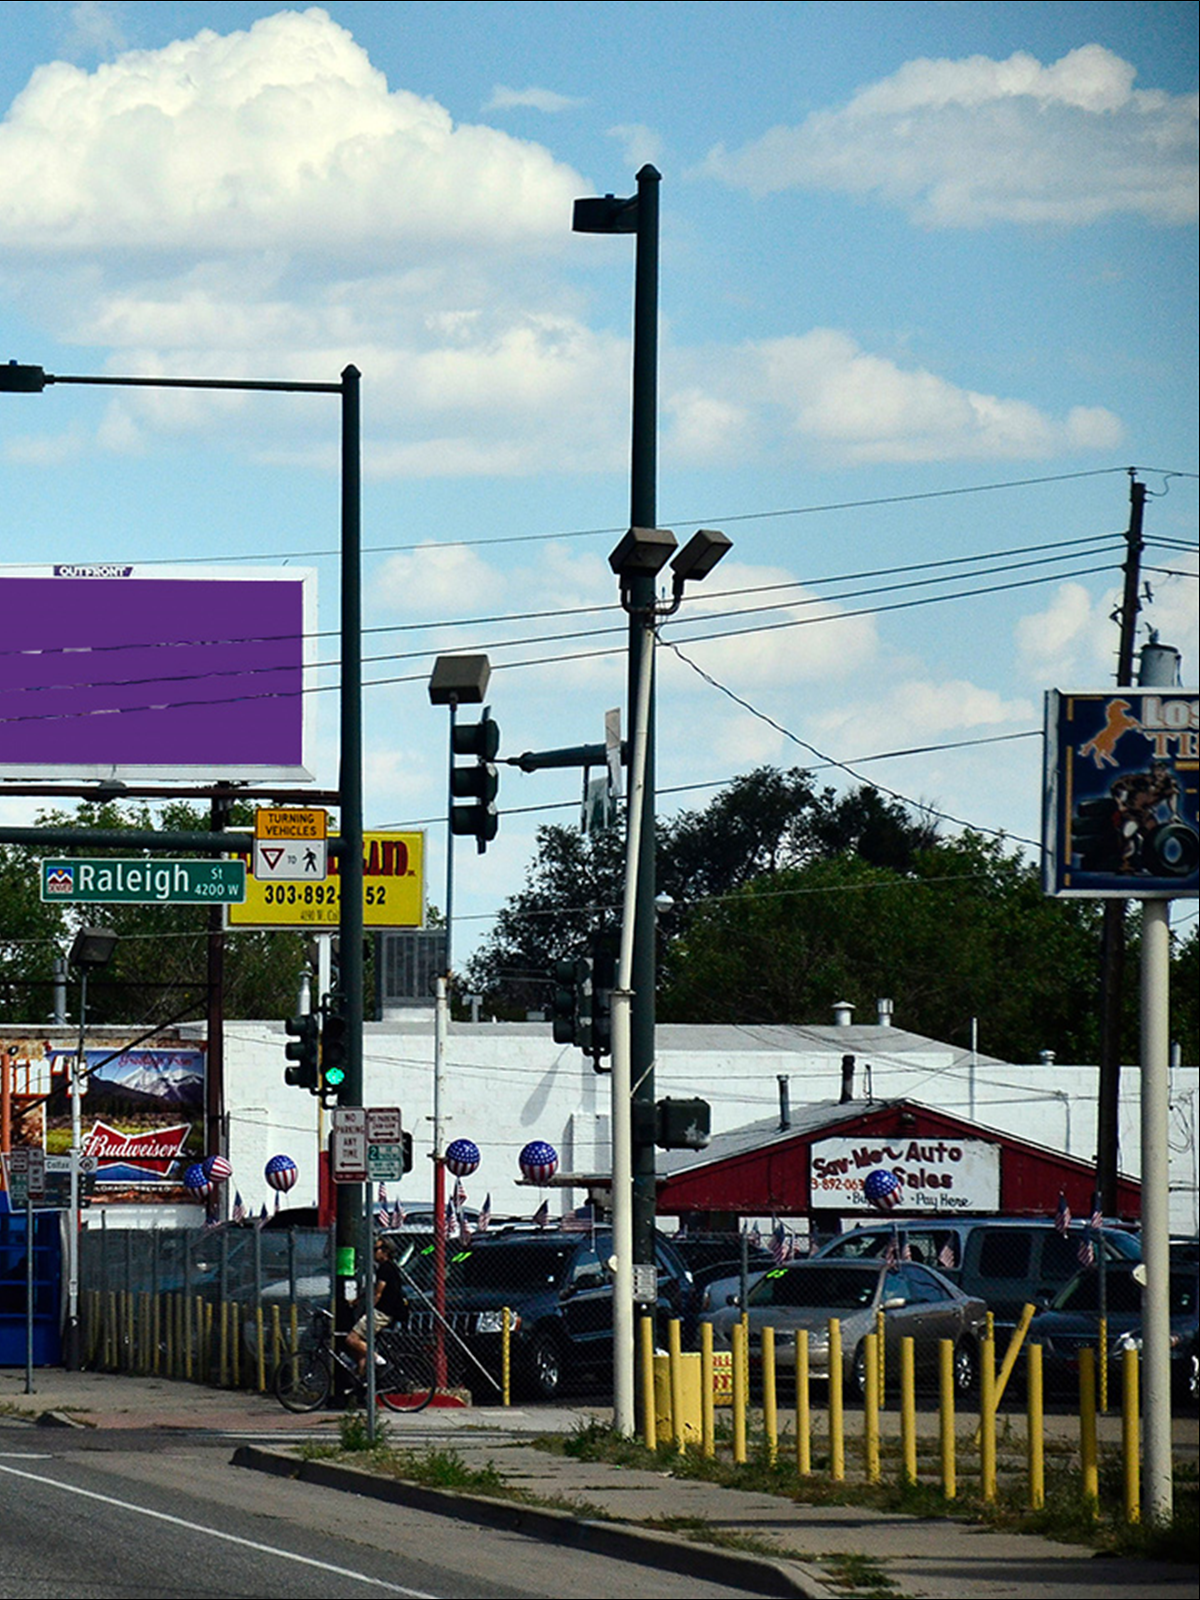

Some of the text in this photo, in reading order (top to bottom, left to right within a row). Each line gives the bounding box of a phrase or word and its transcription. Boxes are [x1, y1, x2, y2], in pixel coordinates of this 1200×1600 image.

[58, 565, 127, 578] OUTFRONT
[267, 813, 315, 825] TURNING
[265, 826, 317, 837] VEHICLES
[210, 867, 224, 880] St
[78, 862, 190, 900] Raleigh
[194, 883, 240, 896] 4200 W
[343, 1112, 357, 1122] NO
[334, 1125, 365, 1134] PARKING
[81, 1132, 182, 1158] Budweiser
[343, 1137, 358, 1147] ANY
[905, 1141, 963, 1163] Auto
[891, 1166, 953, 1190] Sales
[915, 1192, 939, 1210] Pay
